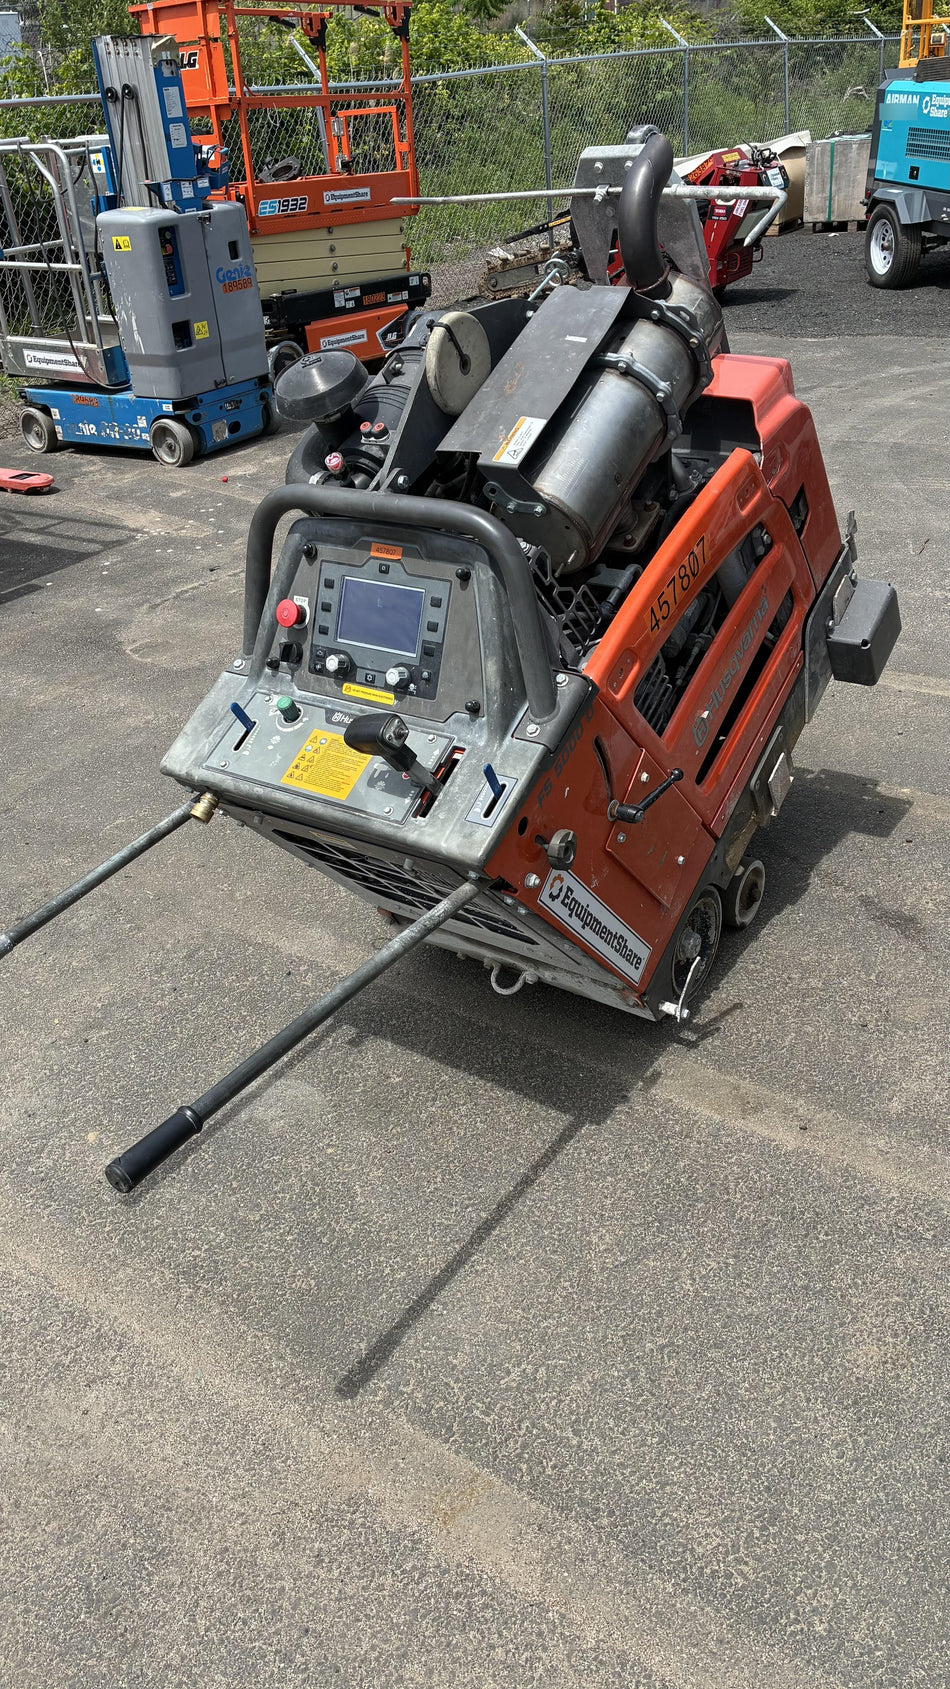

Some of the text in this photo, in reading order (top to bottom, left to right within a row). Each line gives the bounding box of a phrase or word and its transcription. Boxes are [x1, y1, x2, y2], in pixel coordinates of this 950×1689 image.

[885, 93, 920, 106] AIRMAN
[930, 106, 948, 118] Share
[259, 196, 307, 215] ES1932
[330, 191, 369, 202] EquipmentShare
[215, 263, 252, 284] Genie
[327, 333, 365, 346] EquipmentShare
[375, 547, 397, 556] 457807
[650, 535, 706, 632] 457807
[706, 596, 769, 720] Husqvarna
[537, 778, 552, 808] FS
[554, 723, 583, 777] 5000
[561, 885, 642, 970] EquipmentShare
